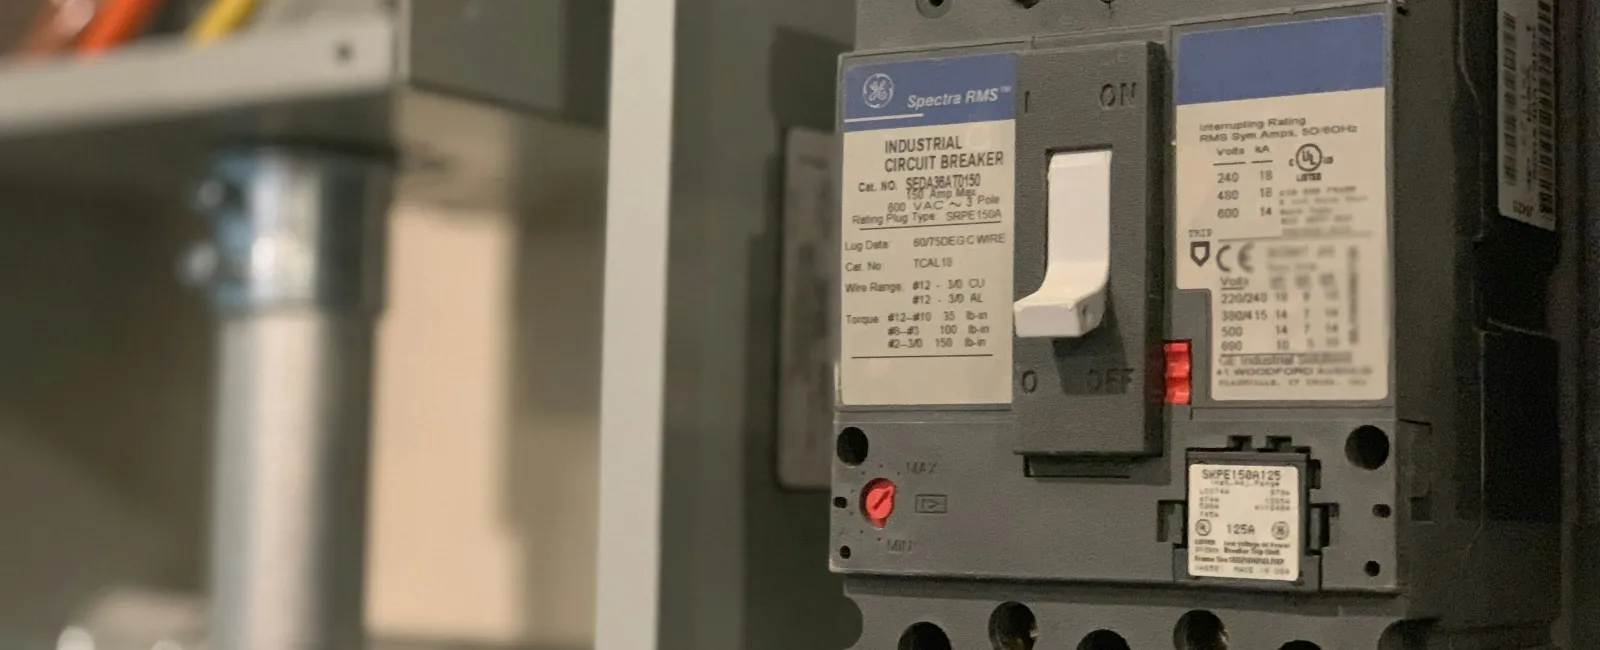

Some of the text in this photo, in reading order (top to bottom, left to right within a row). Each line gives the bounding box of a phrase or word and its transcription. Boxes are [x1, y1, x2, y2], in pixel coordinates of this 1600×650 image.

[1100, 82, 1137, 107] ON
[907, 93, 961, 110] Spectra
[1199, 116, 1306, 133] Interrupting Rating
[1199, 132, 1228, 143] RMS
[1231, 131, 1257, 143] Sym
[1302, 125, 1358, 137] 50/60Hz
[884, 135, 963, 154] INDUSTRIAL
[1216, 145, 1270, 156] Volts kA
[884, 151, 1004, 173] CIRCUIT BREAKER
[1217, 170, 1273, 183] 240 18
[929, 188, 952, 200] Amp
[1217, 189, 1239, 201] 480
[1259, 187, 1273, 198] 18
[913, 200, 943, 211] VAC
[977, 194, 1000, 205] Pole
[1217, 207, 1239, 219] 600
[1259, 206, 1272, 217] 14
[852, 215, 884, 226] Rating
[886, 213, 908, 225] Plug
[845, 240, 862, 252] Lug
[977, 233, 1005, 244] WIRE
[845, 283, 867, 293] Wire
[912, 280, 931, 291] #12
[968, 278, 985, 288] CU
[912, 294, 931, 305] #12
[970, 293, 983, 303] AL
[1221, 293, 1267, 304] 220/240
[943, 311, 955, 321] 35
[966, 310, 988, 320] lb-in
[1276, 309, 1288, 320] 14
[940, 325, 957, 335] 100
[968, 325, 990, 334] lb-in
[1221, 325, 1243, 337] 500
[1276, 325, 1288, 335] 14
[935, 338, 953, 348] 150
[964, 338, 986, 347] lb-in
[1221, 340, 1243, 351] 690
[1241, 354, 1294, 366] Industrial
[1234, 366, 1314, 376] WOODFORD
[1086, 367, 1134, 395] OFF
[1226, 524, 1255, 535] 125A
